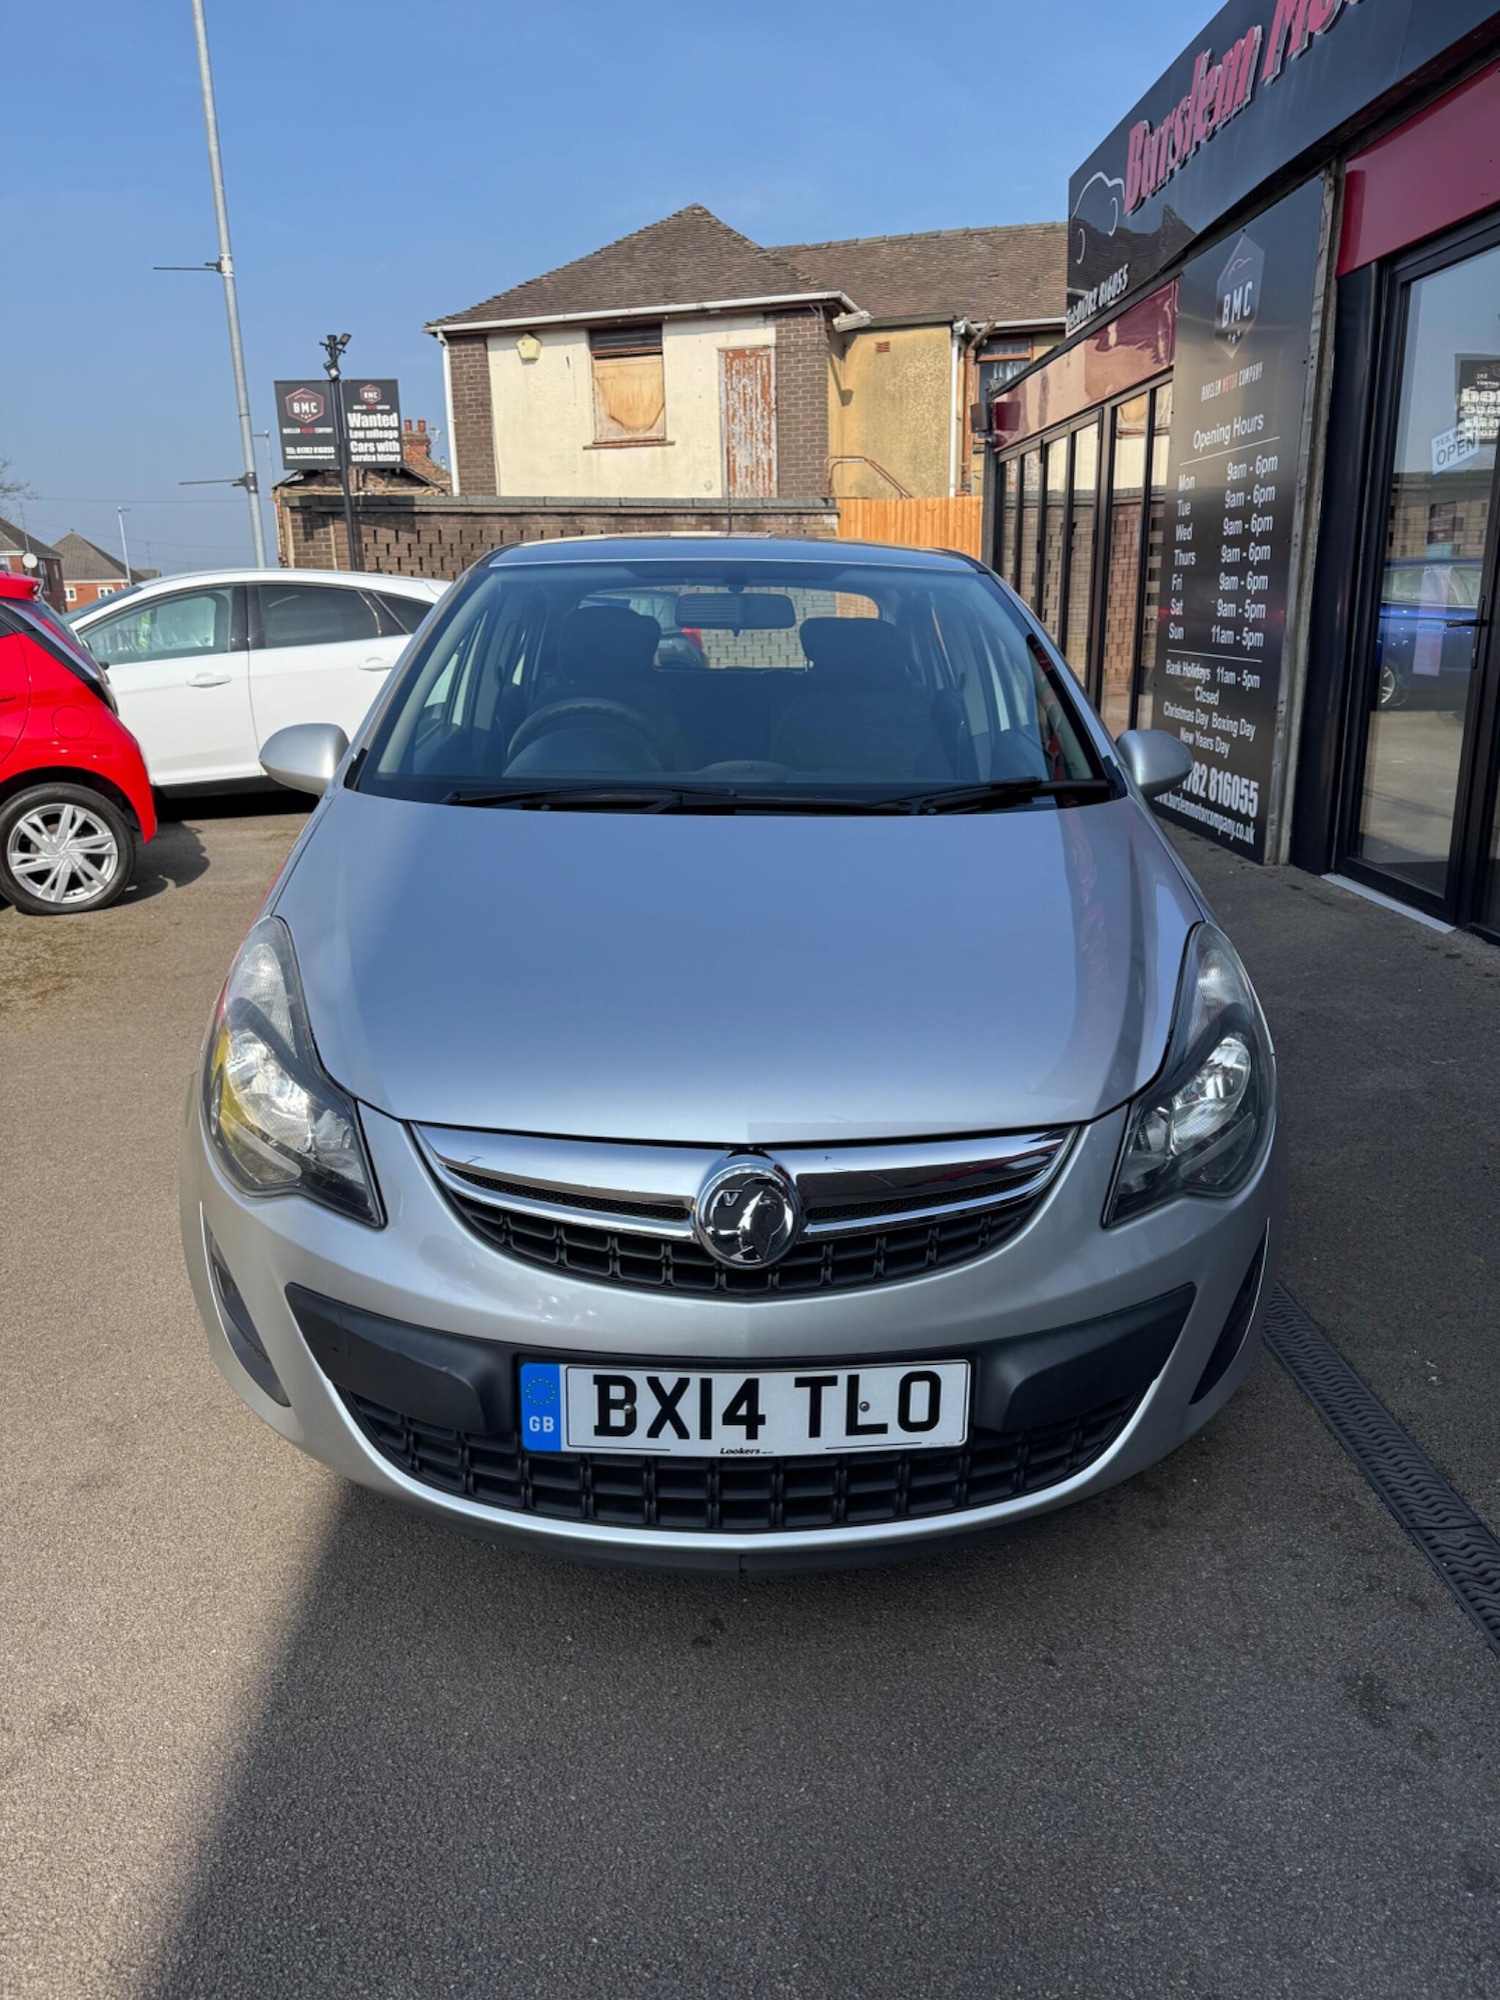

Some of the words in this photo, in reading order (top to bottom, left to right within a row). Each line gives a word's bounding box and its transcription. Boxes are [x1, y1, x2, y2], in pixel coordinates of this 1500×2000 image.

[1124, 25, 1261, 216] Burslem
[1222, 281, 1253, 328] BMC
[293, 402, 318, 413] BMC
[347, 412, 399, 428] Wanted
[350, 440, 376, 453] Cars
[376, 440, 400, 453] with
[1193, 422, 1231, 453] Opening
[1232, 414, 1264, 438] Hours
[1436, 431, 1476, 466] OPEN
[1179, 474, 1195, 492] Mon
[1227, 462, 1247, 481] 9am
[1255, 455, 1279, 479] 6pm
[1177, 499, 1191, 517] Tue
[1225, 490, 1245, 509] 9am
[1253, 484, 1276, 508] 6pm
[1175, 522, 1193, 541] Wed
[1222, 517, 1243, 536] 9am
[1250, 512, 1274, 538] 6pm
[1174, 549, 1196, 566] Thurs
[1221, 544, 1241, 563] 9am
[1248, 541, 1271, 566] 6pm
[1171, 573, 1183, 591] Fri
[1219, 572, 1239, 591] 9am
[1246, 570, 1269, 595] 6pm
[1170, 598, 1183, 616] Sat
[1217, 598, 1236, 617] 9am
[1244, 598, 1266, 623] 5pm
[1168, 622, 1184, 640] Sun
[1211, 624, 1234, 644] 11am
[1242, 626, 1264, 650] 5pm
[1165, 659, 1180, 676] Bank
[1180, 661, 1212, 684] Holidays
[1216, 666, 1236, 685] 11am
[1241, 670, 1261, 691] 5pm
[1194, 686, 1220, 706] Closed
[1163, 701, 1195, 724] Christmas
[1195, 708, 1210, 730] Day
[1211, 712, 1239, 738] Boxing
[1239, 718, 1256, 742] Day
[1180, 727, 1195, 744] New
[1195, 729, 1214, 751] Years
[1214, 737, 1231, 759] Day
[1208, 766, 1260, 819] 816055
[592, 1373, 767, 1441] BX14
[793, 1370, 942, 1439] TLO
[528, 1416, 555, 1434] GB
[719, 1446, 761, 1456] Lookers
